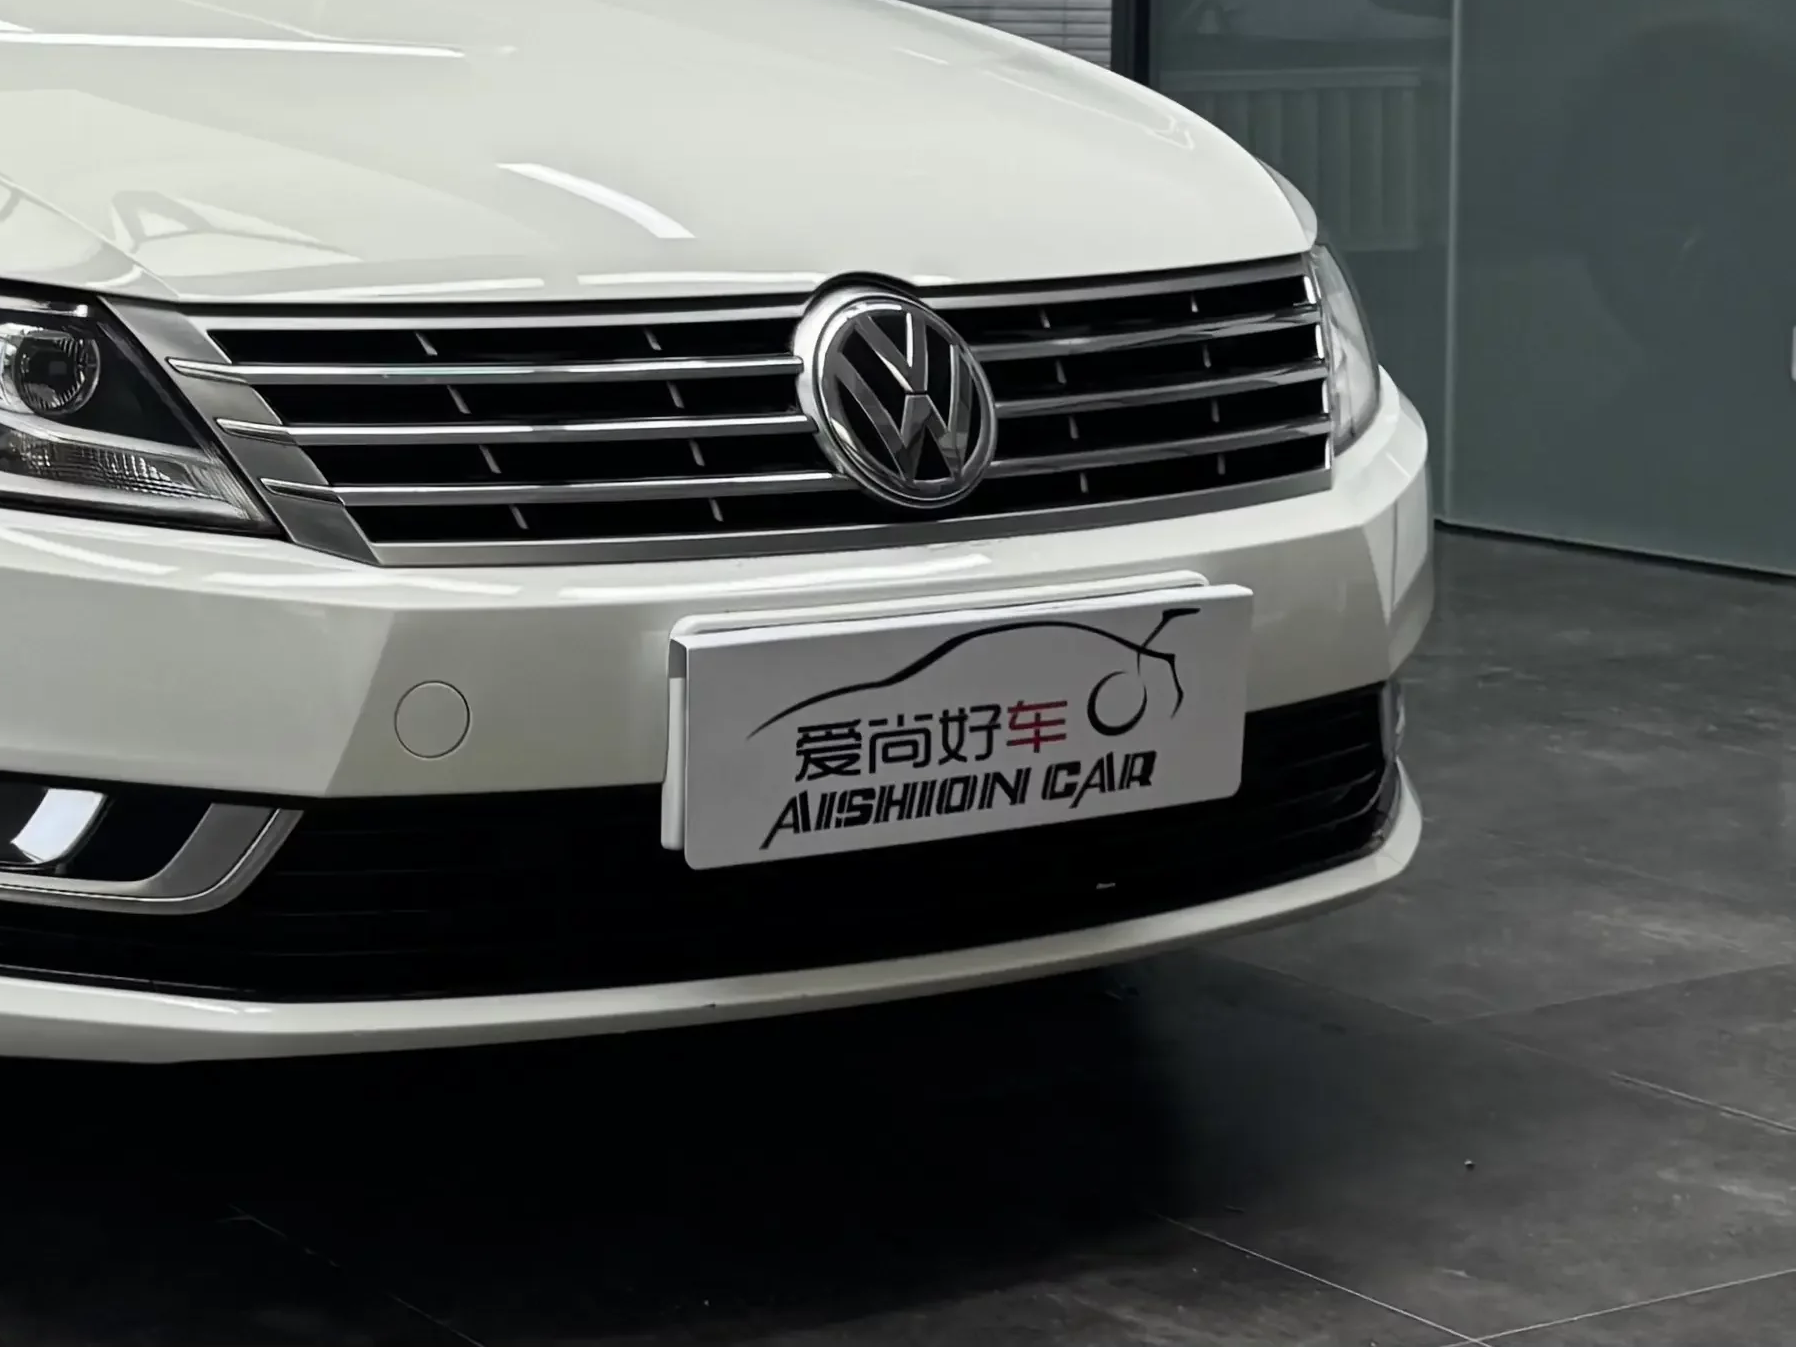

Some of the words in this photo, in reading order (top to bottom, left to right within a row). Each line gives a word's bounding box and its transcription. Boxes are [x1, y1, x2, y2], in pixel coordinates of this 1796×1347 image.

[794, 699, 1068, 782] 爱尚好车
[758, 765, 1031, 850] AISHION
[1040, 749, 1158, 810] CAR
